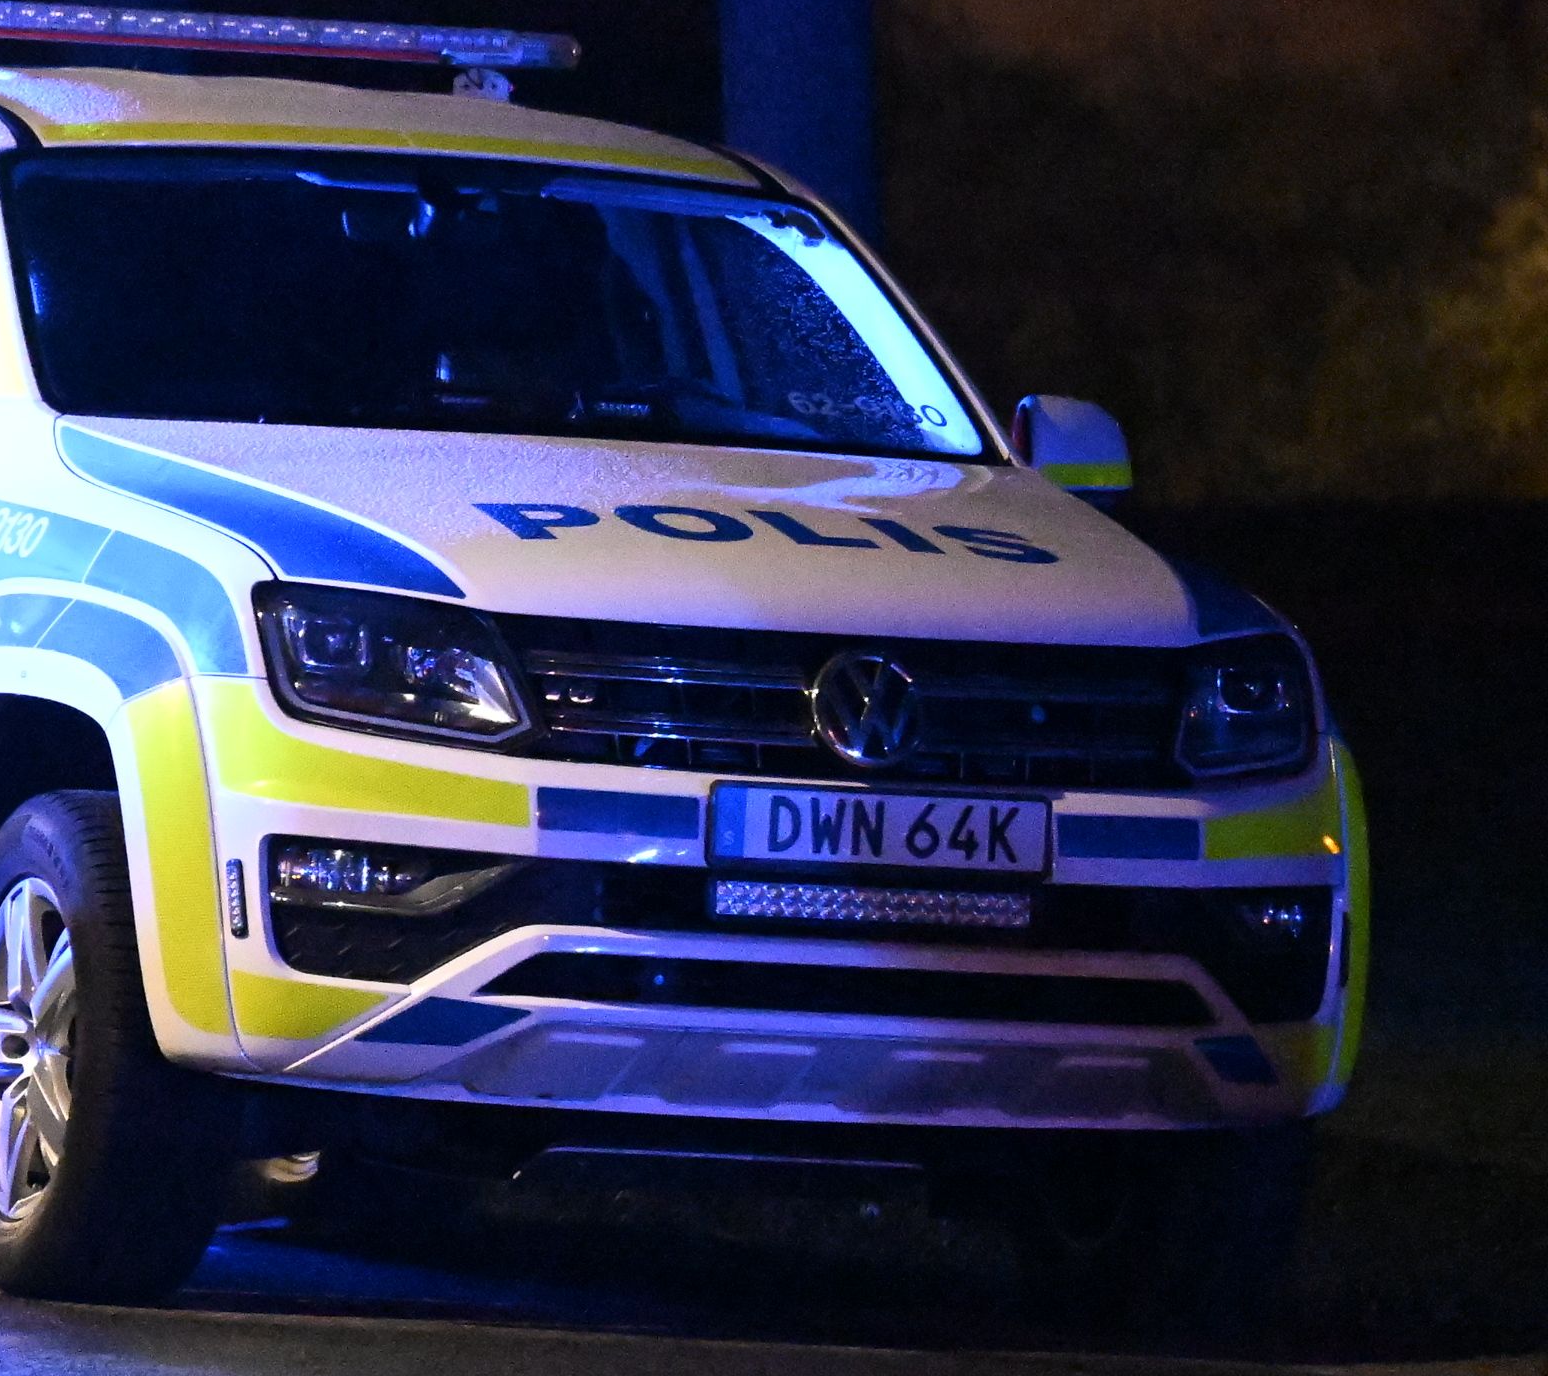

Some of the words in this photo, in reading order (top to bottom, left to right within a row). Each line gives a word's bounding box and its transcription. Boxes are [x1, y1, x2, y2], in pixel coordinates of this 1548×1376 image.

[471, 503, 1060, 565] POLIS
[767, 794, 885, 858] DWN
[906, 803, 1019, 864] 64K
